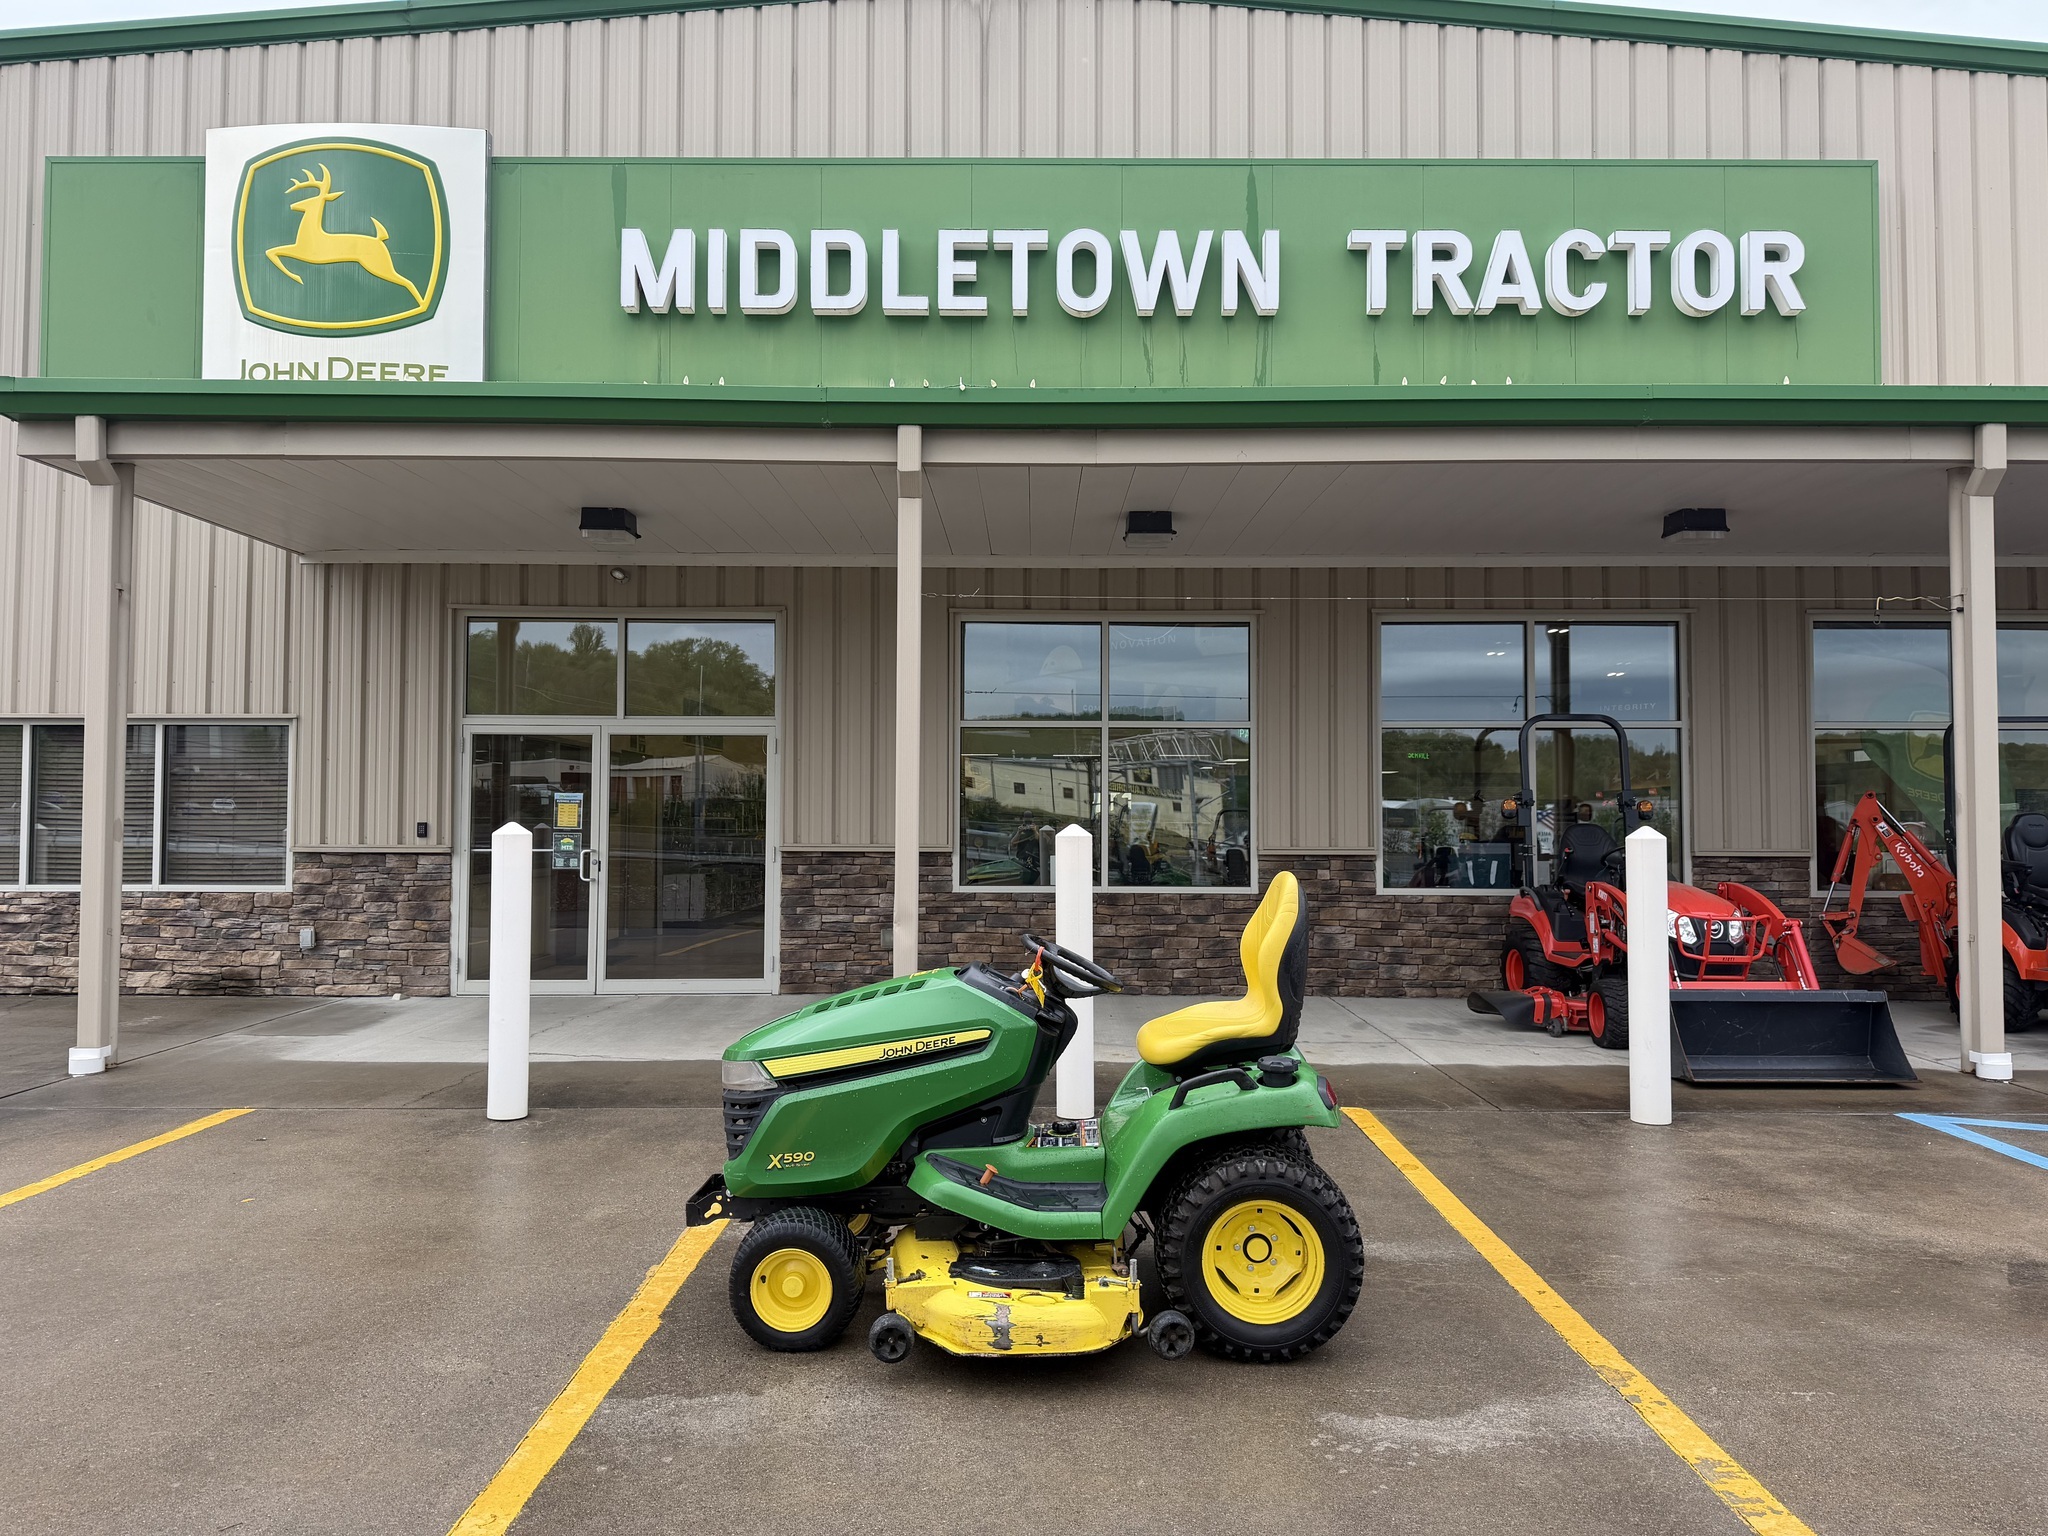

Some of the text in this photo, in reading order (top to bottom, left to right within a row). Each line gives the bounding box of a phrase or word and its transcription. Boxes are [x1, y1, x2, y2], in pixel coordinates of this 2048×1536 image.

[620, 228, 1806, 317] MIDDLETOWN TRACTOR
[239, 356, 449, 382] JOHN DEERE
[1111, 635, 1176, 650] NOVATION
[1600, 702, 1656, 711] INTEGRITY
[1895, 842, 1924, 878] Kubota
[879, 1036, 956, 1059] JOHN DEERE
[766, 1151, 815, 1170] X590
